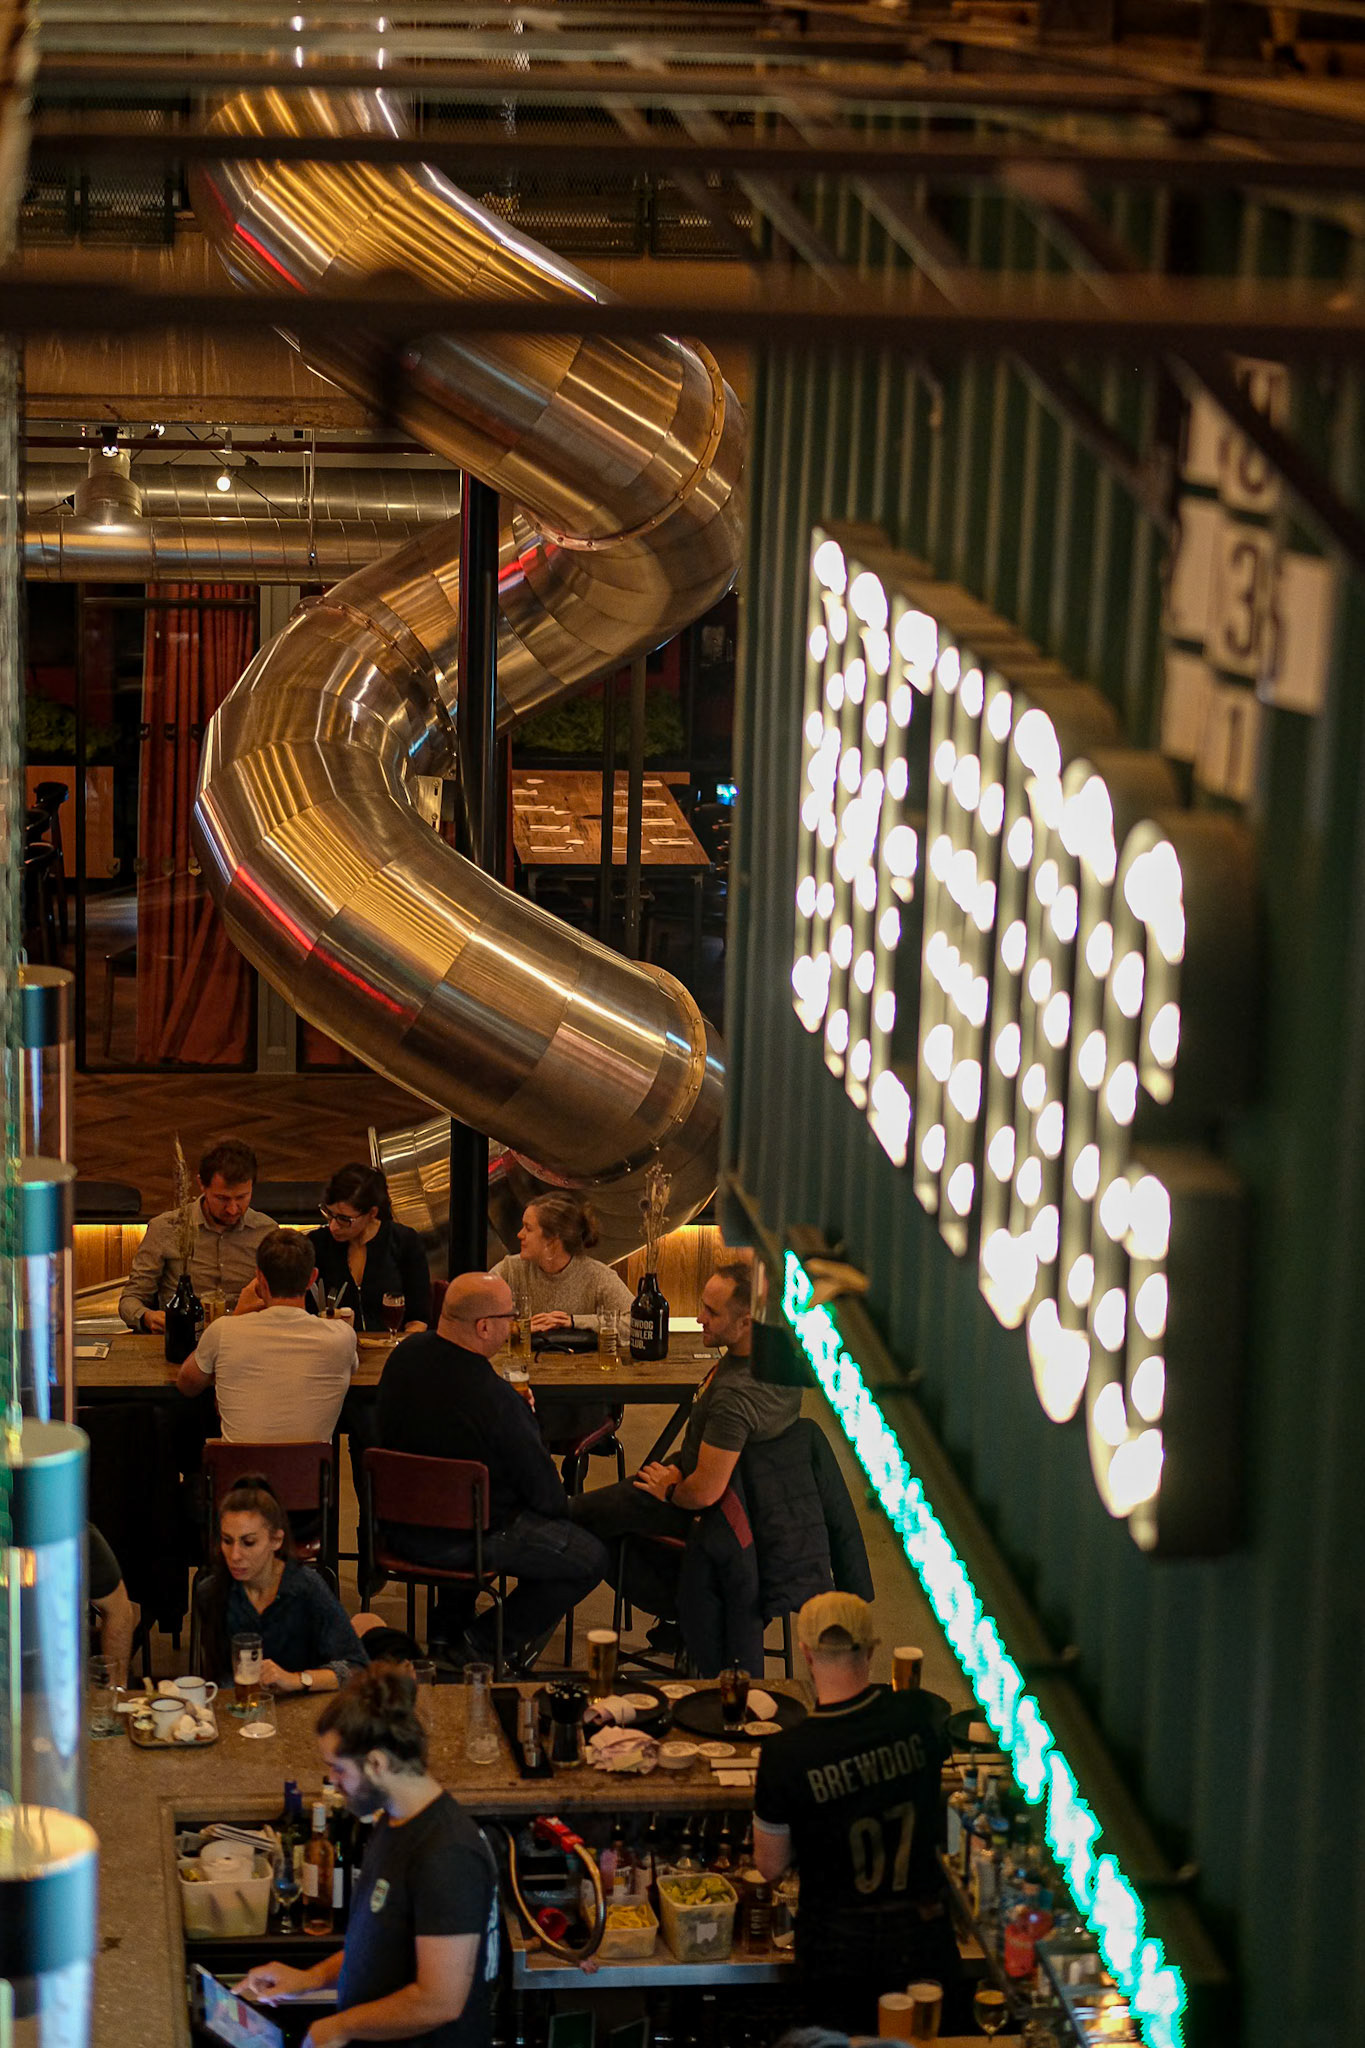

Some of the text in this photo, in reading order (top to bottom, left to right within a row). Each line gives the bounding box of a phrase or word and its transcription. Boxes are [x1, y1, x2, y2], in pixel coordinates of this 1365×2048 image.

[631, 1317, 654, 1330] EWDOG
[808, 1733, 927, 1804] BREWDOG
[849, 1800, 916, 1894] 07
